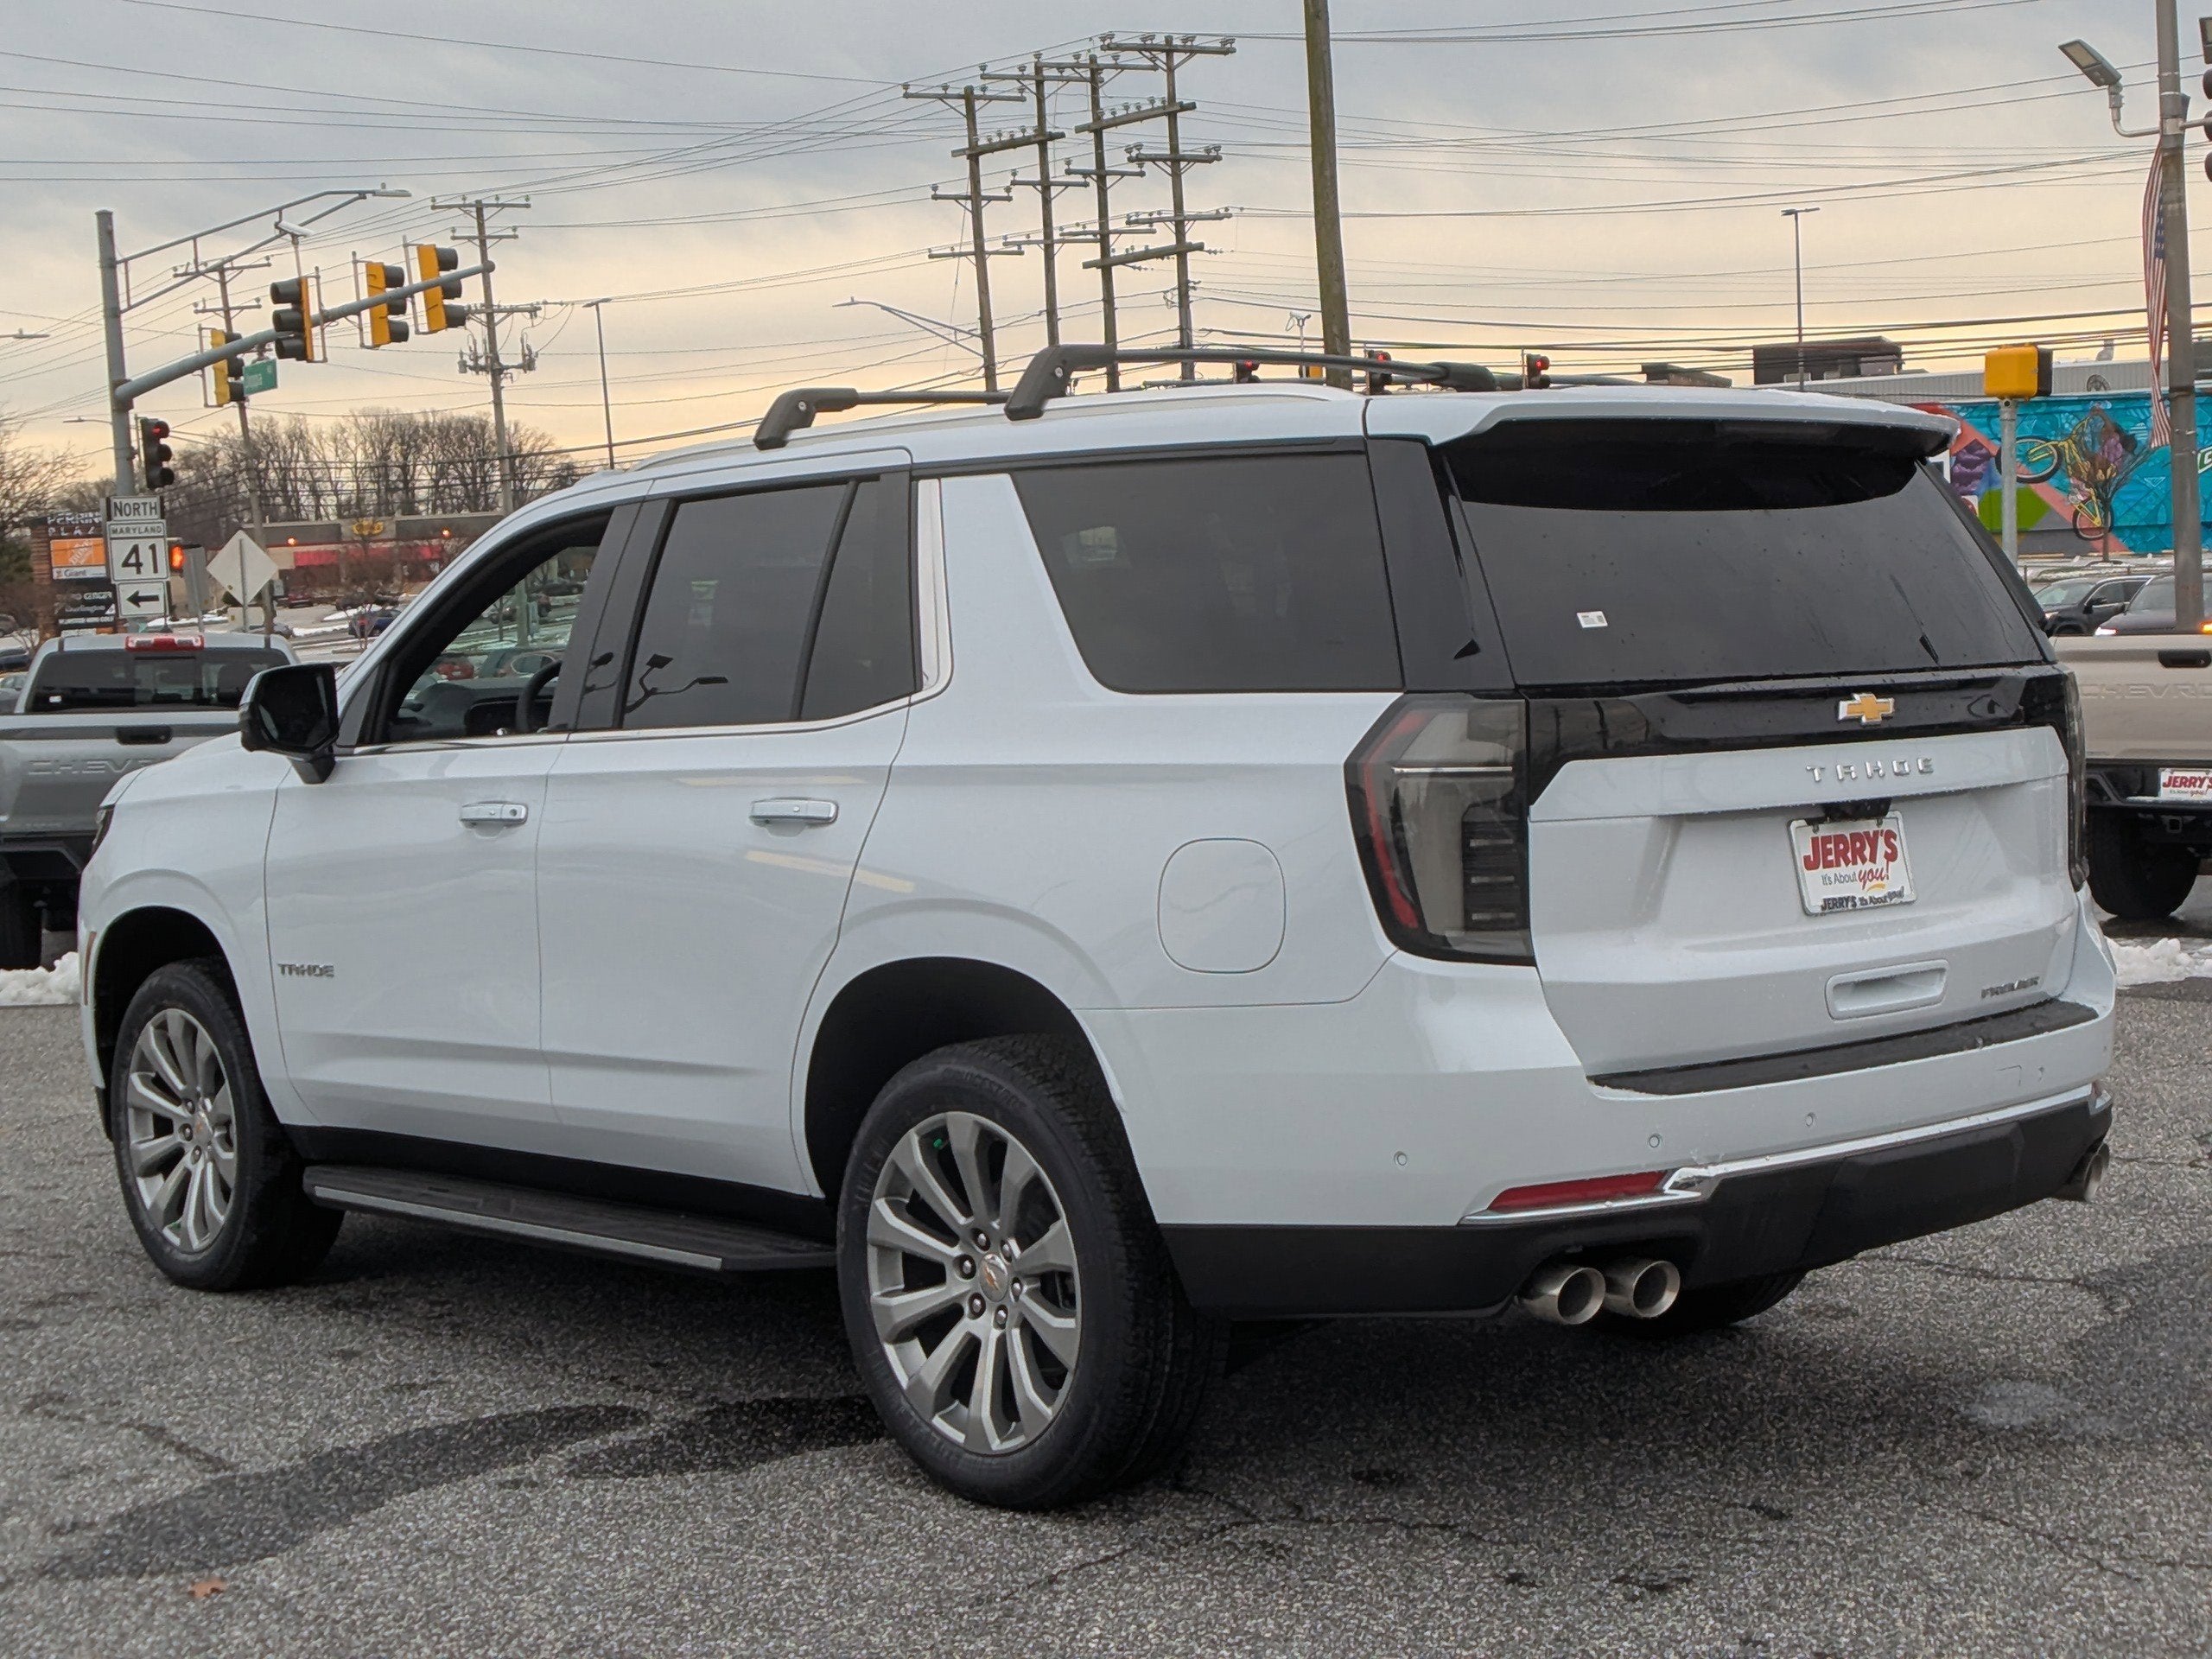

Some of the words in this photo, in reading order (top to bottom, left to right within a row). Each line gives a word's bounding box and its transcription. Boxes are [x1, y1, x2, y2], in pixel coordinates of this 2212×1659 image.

[113, 501, 158, 518] NORTH
[48, 526, 97, 537] PLAZ
[111, 525, 162, 535] MARYLAND
[121, 543, 159, 575] 41
[1806, 757, 1935, 783] TAHOE
[1802, 829, 1898, 871] JERRY'S
[1834, 871, 1857, 885] About
[1858, 862, 1890, 890] you!
[276, 963, 335, 978] TAHOE
